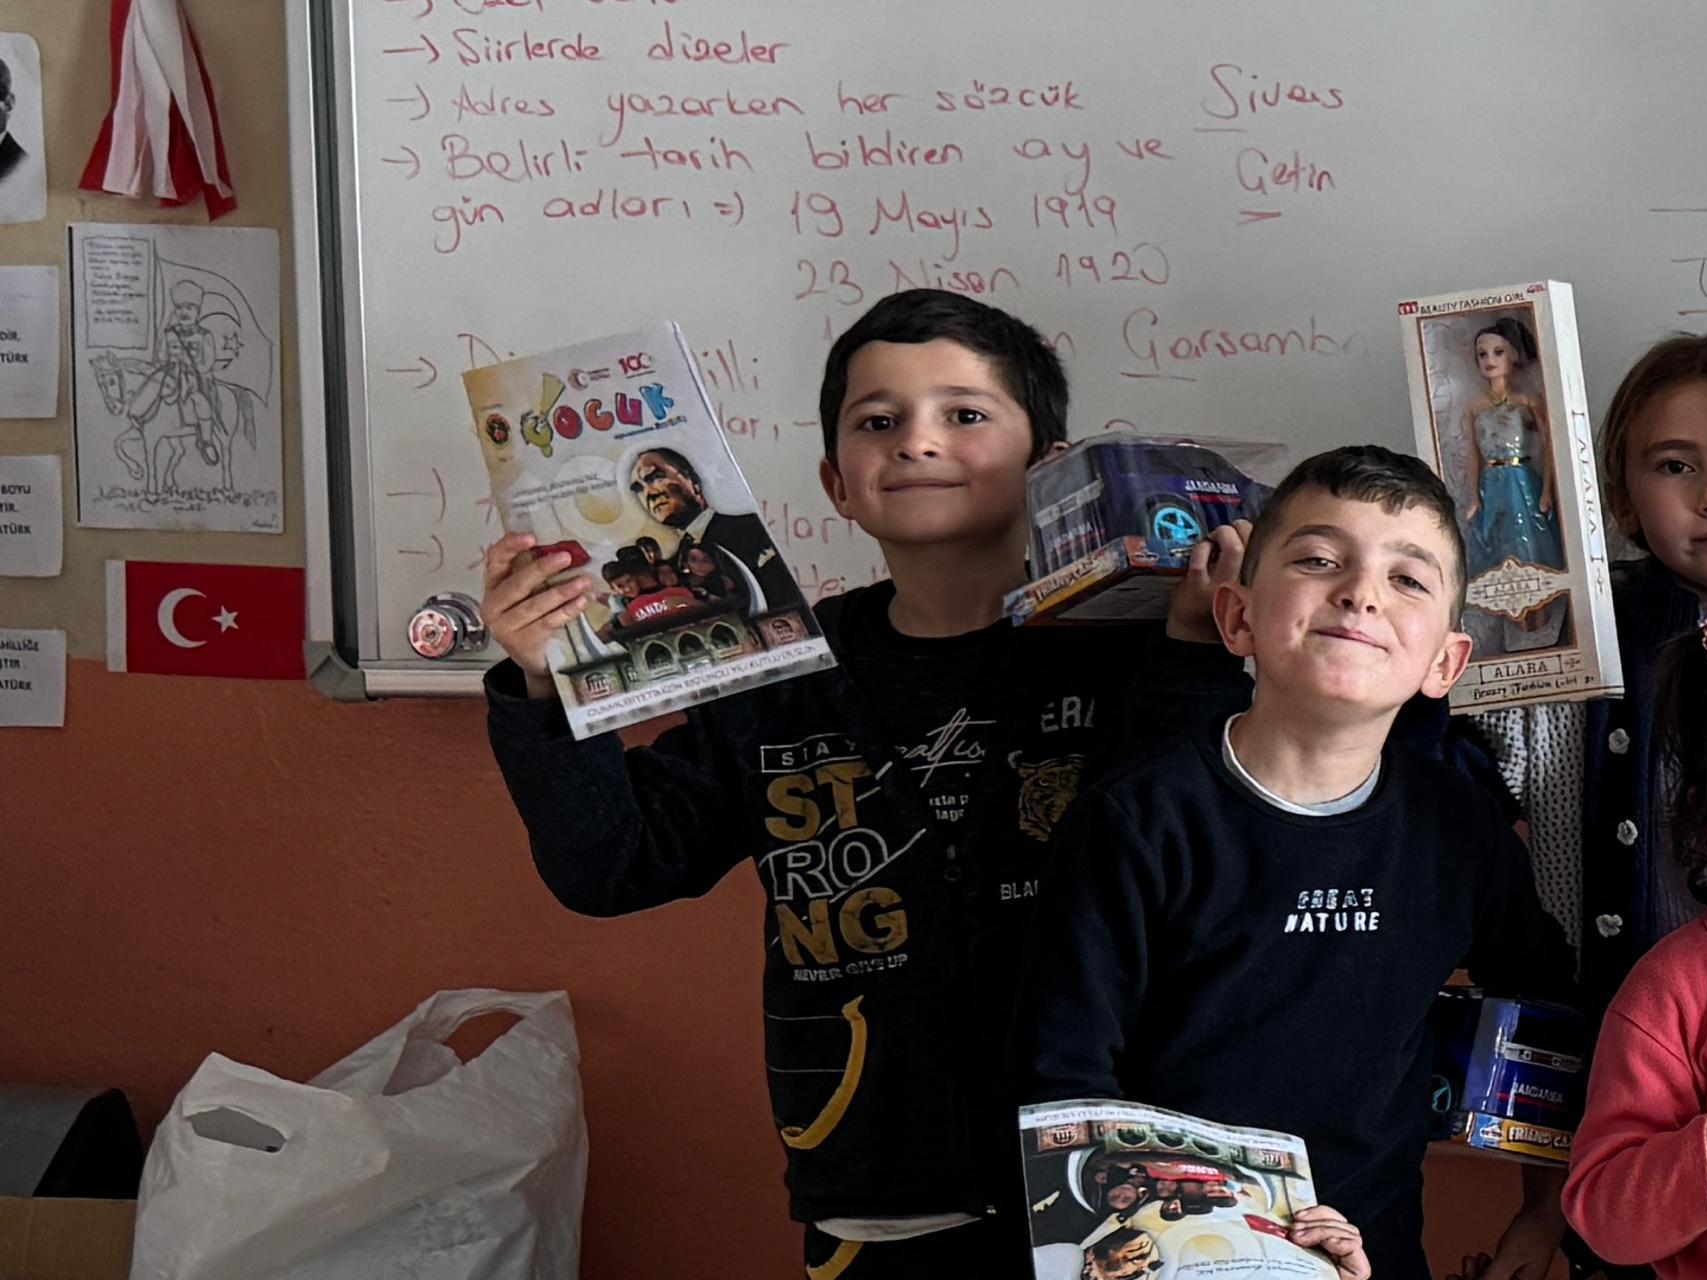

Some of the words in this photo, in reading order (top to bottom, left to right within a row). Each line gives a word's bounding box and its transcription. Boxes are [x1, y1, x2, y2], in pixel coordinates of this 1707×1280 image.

[647, 21, 791, 65] dizeler
[451, 83, 556, 123] Adres
[599, 90, 805, 148] yazarken
[837, 81, 900, 115] her
[936, 79, 1086, 112] sözcük
[441, 133, 588, 182] Belirli
[620, 136, 753, 172] tarih
[805, 130, 964, 171] bildiren
[1013, 139, 1092, 196] ay
[1116, 138, 1175, 161] ve
[431, 196, 505, 254] gün
[542, 188, 692, 220] adları
[791, 189, 845, 238] 19
[869, 195, 994, 261] Mayıs
[795, 259, 865, 305] 23
[1056, 242, 1170, 287] 1920
[1493, 662, 1549, 680] ALARA
[1284, 911, 1380, 933] NATURE
[888, 953, 909, 968] UP
